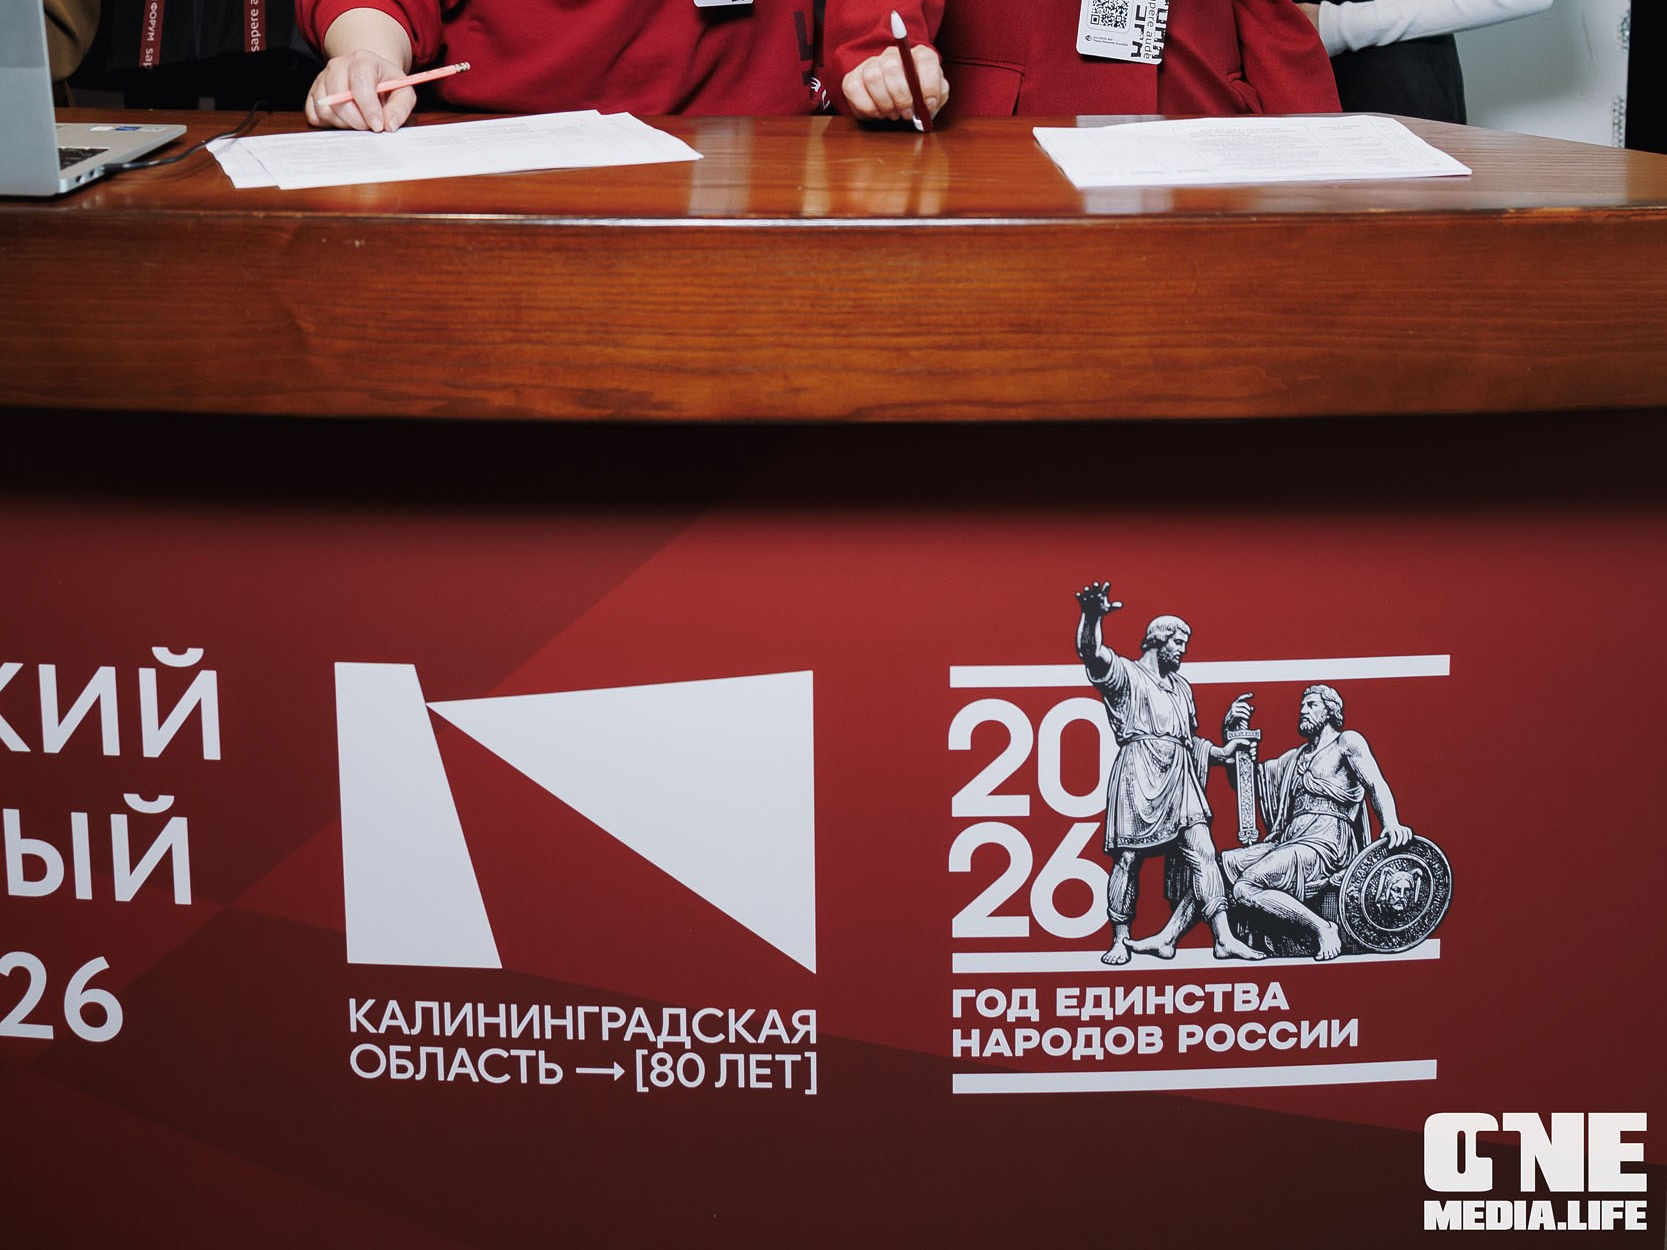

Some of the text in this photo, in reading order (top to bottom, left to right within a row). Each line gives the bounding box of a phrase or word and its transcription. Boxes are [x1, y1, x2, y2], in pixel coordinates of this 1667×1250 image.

[145, 2, 159, 41] ФОРУМ
[249, 7, 262, 52] sapere
[1143, 30, 1154, 60] aude
[948, 697, 1108, 818] 20
[948, 821, 1110, 939] 26
[349, 998, 817, 1049] КАЛИНИНГРАДСКАЯ
[952, 982, 1289, 1021] ГОД ЕДИНСТВА
[952, 1019, 1359, 1060] НАРОДОВ РОССИИ
[349, 1043, 817, 1095] ОБЛАСТЬ [80 ЛЕТ]
